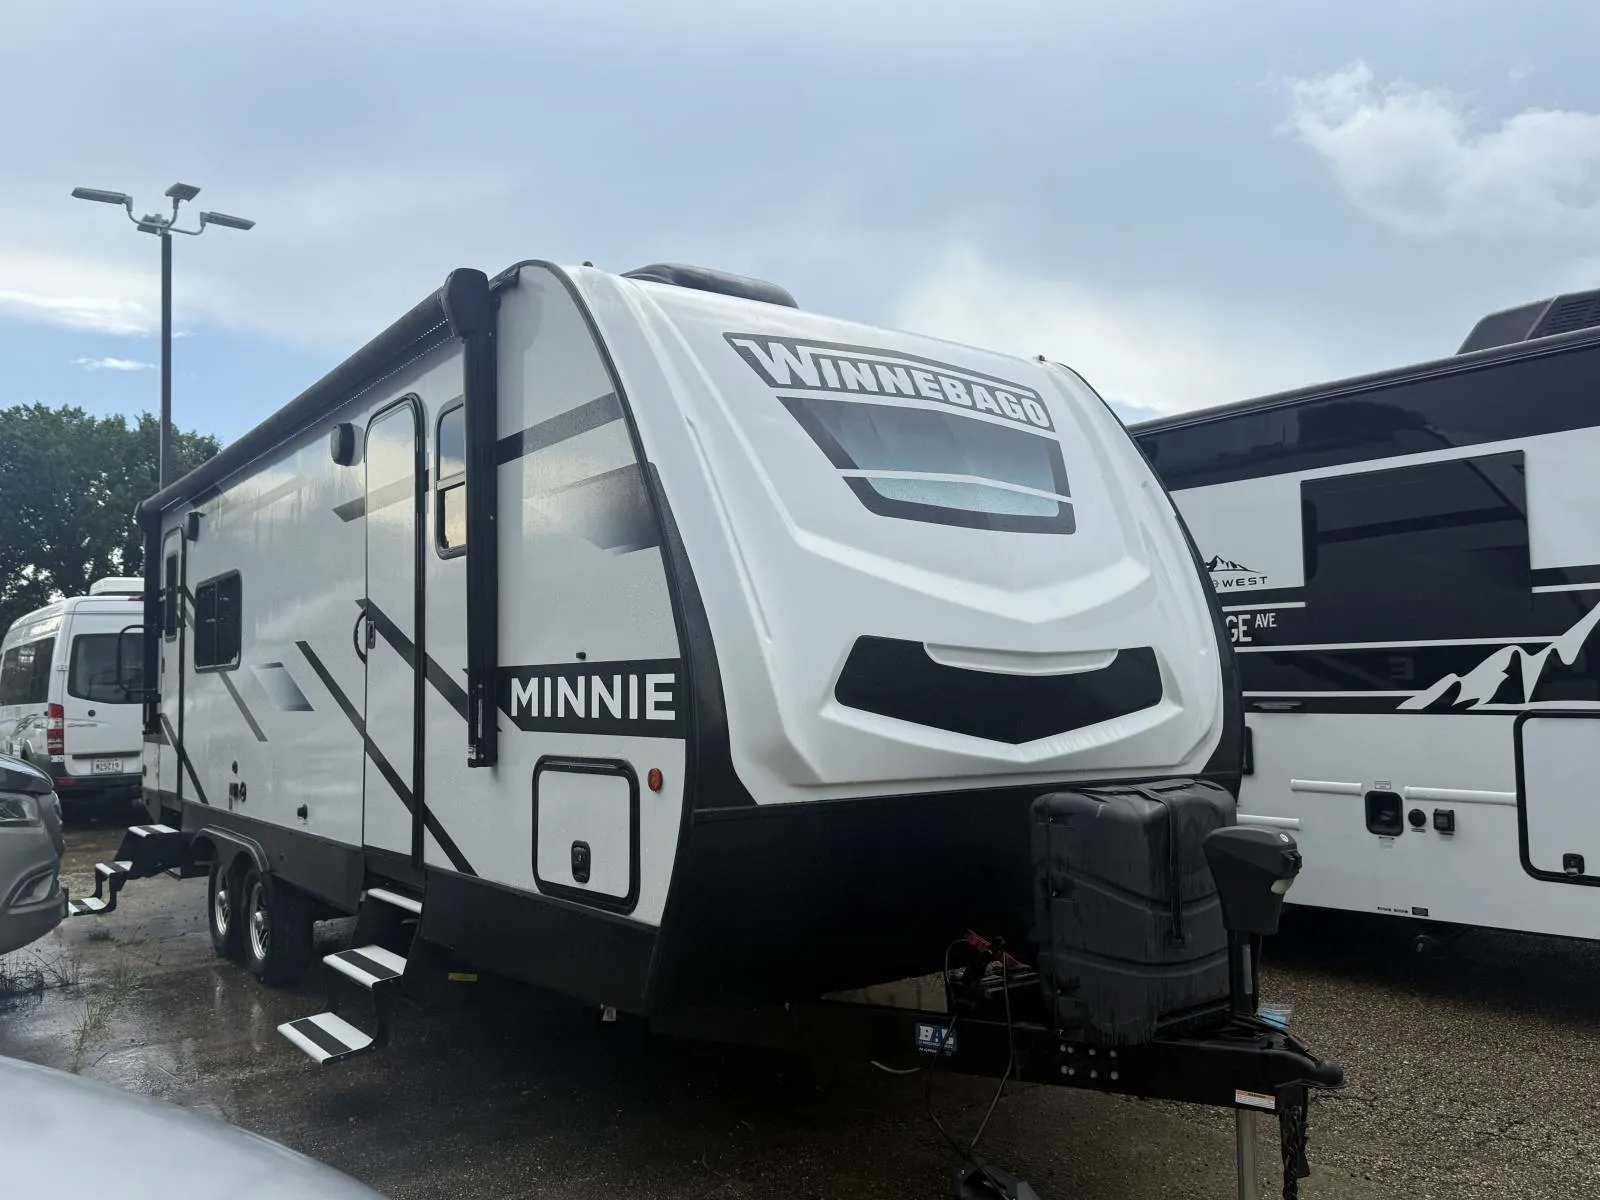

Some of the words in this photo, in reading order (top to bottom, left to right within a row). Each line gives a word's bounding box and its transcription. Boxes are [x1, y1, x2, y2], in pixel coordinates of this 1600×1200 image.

[731, 338, 1050, 428] WINNEBAGO
[1222, 576, 1268, 588] WEST
[1254, 612, 1278, 629] AVE
[510, 673, 677, 721] MINNIE
